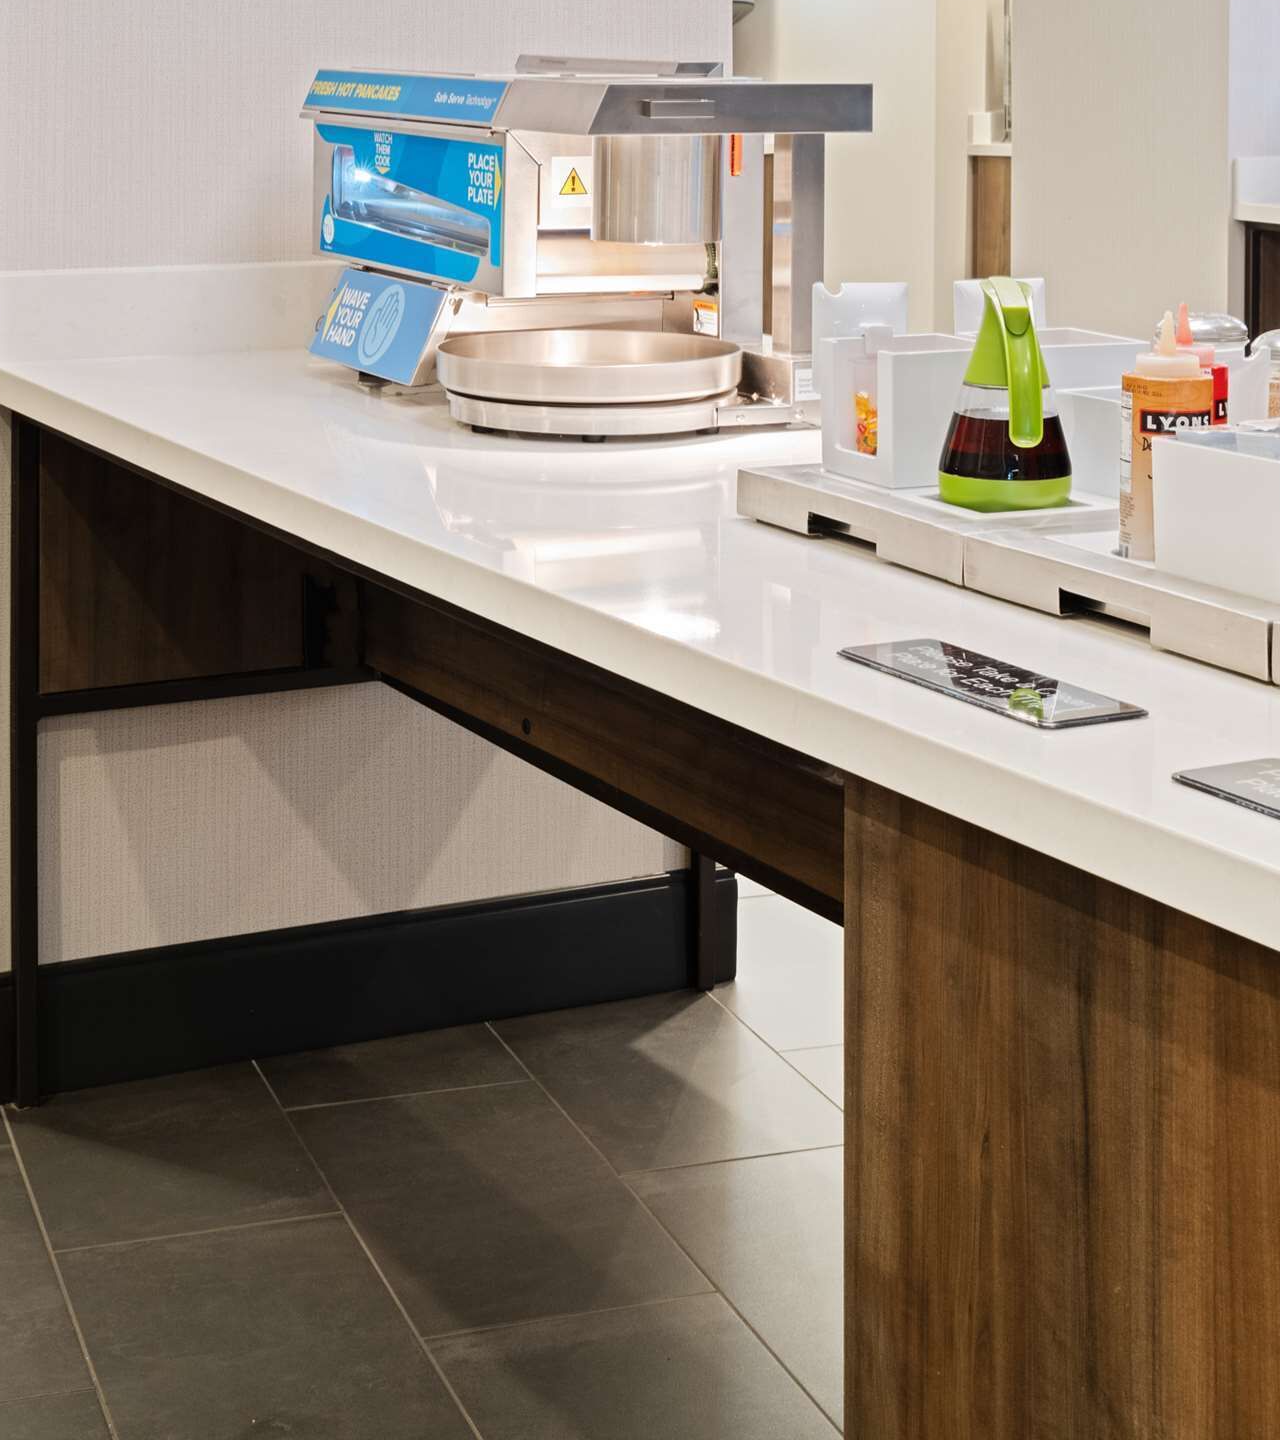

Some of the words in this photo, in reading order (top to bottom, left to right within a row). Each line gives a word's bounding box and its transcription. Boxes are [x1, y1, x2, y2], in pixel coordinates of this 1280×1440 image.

[336, 82, 357, 98] HOT
[354, 83, 401, 101] PANCAKES
[434, 91, 449, 104] Safe
[447, 92, 465, 105] Serve
[373, 133, 393, 145] WATCH
[374, 154, 391, 167] COOK
[467, 152, 495, 171] PLACE
[469, 170, 493, 187] YOUR
[467, 186, 494, 205] PLATE
[341, 287, 372, 310] WAVE
[334, 306, 364, 329] YOUR
[326, 324, 356, 348] HAND
[1146, 415, 1209, 431] LYONS
[972, 665, 1020, 683] Take
